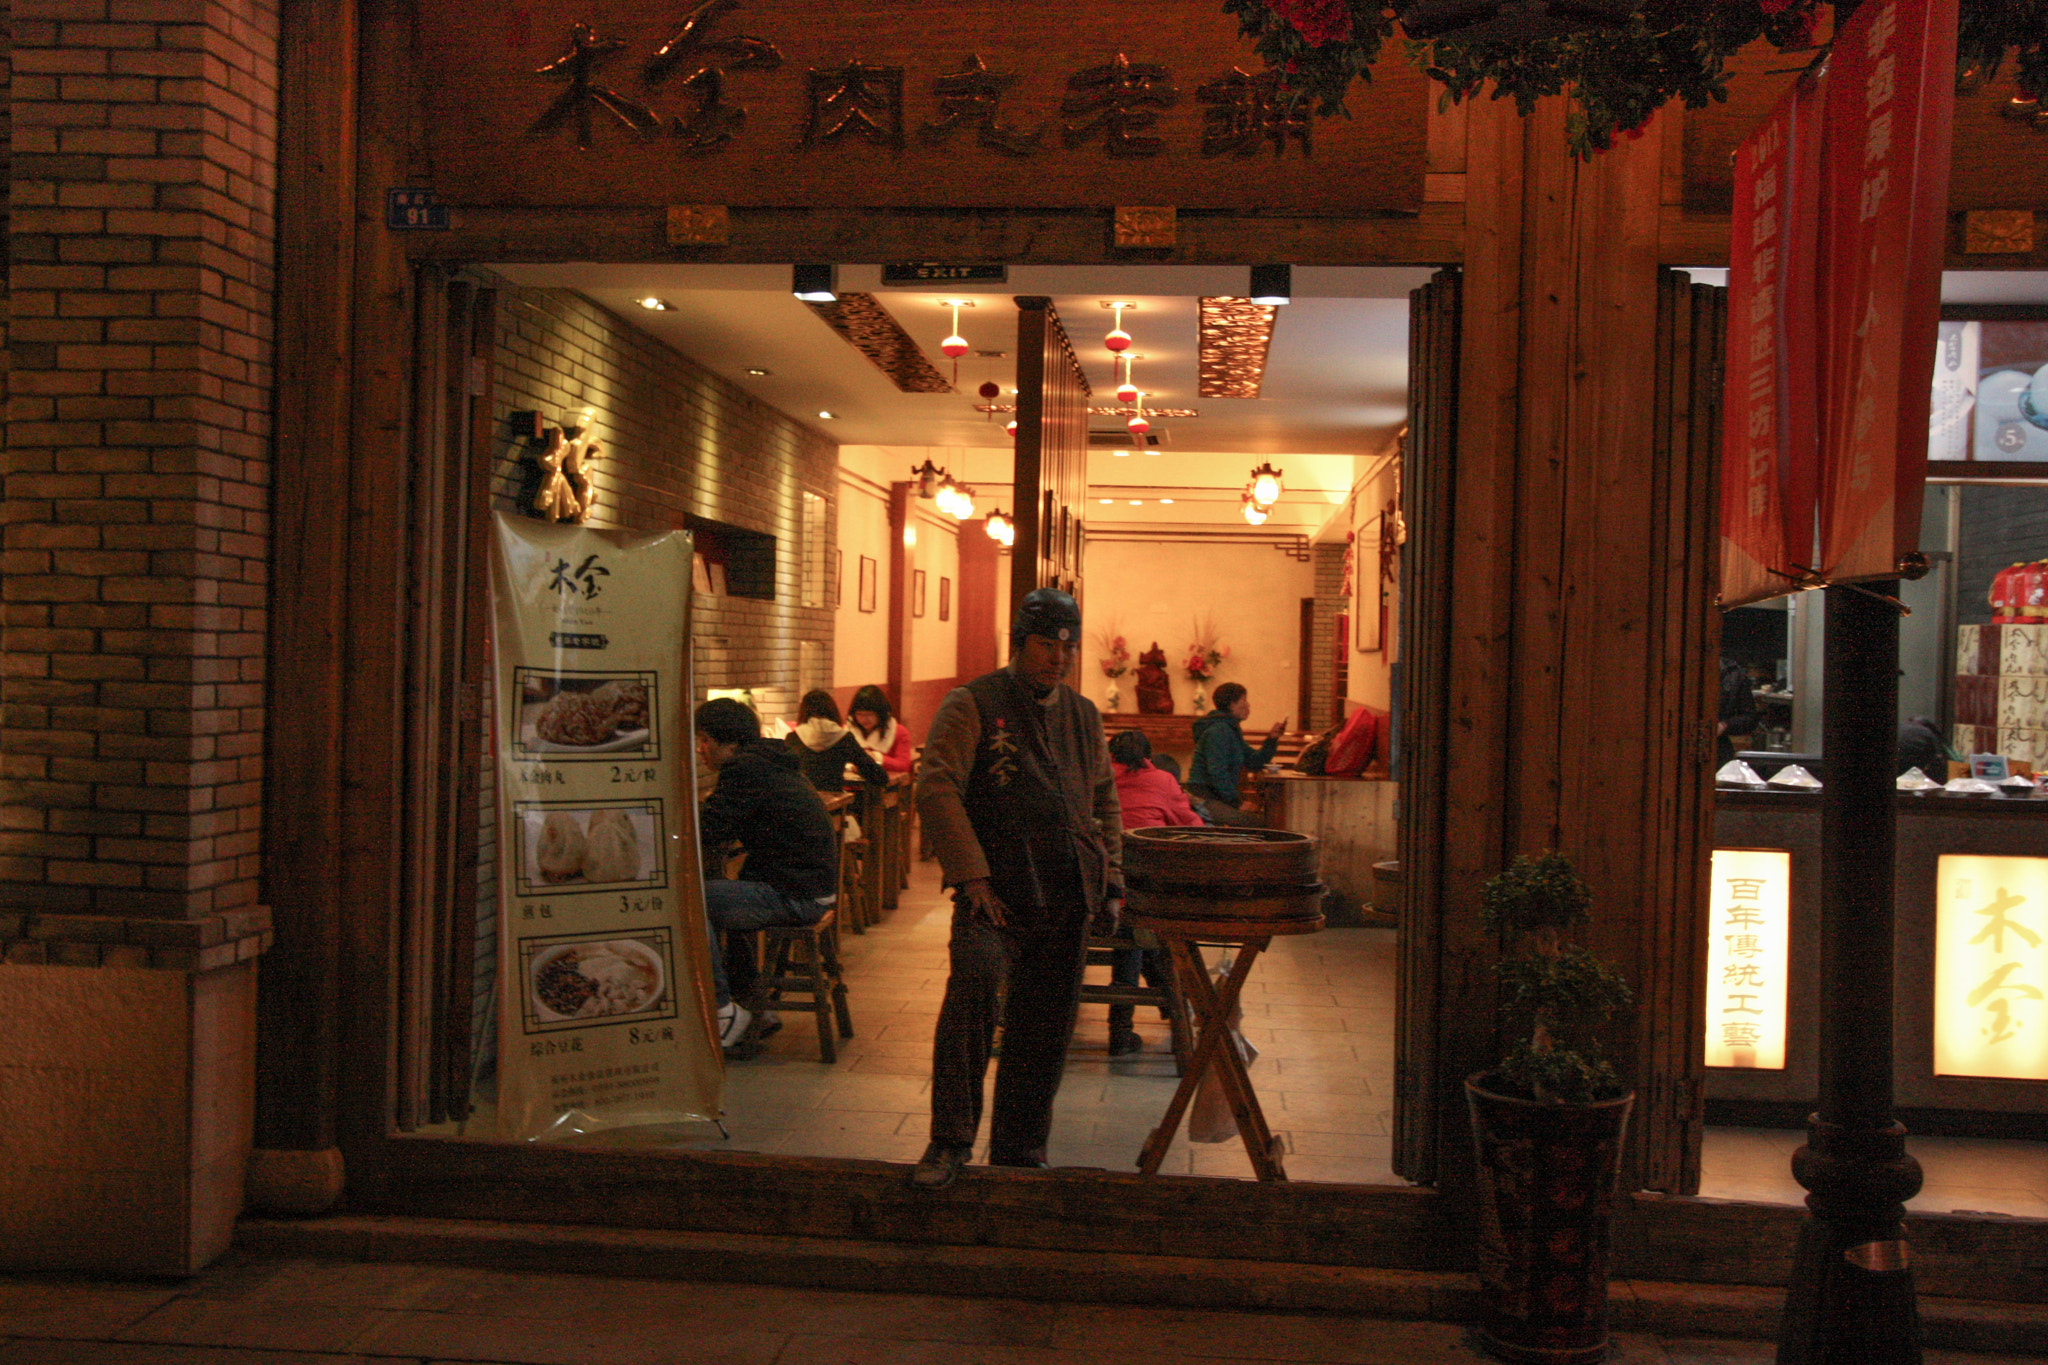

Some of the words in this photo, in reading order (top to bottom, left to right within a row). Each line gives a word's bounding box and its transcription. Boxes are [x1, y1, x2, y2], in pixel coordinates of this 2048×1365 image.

[407, 208, 428, 225] 91
[916, 267, 972, 278] EXIT
[1720, 877, 1768, 1048] 百年傳統工藝
[1965, 886, 2045, 1046] 木金
